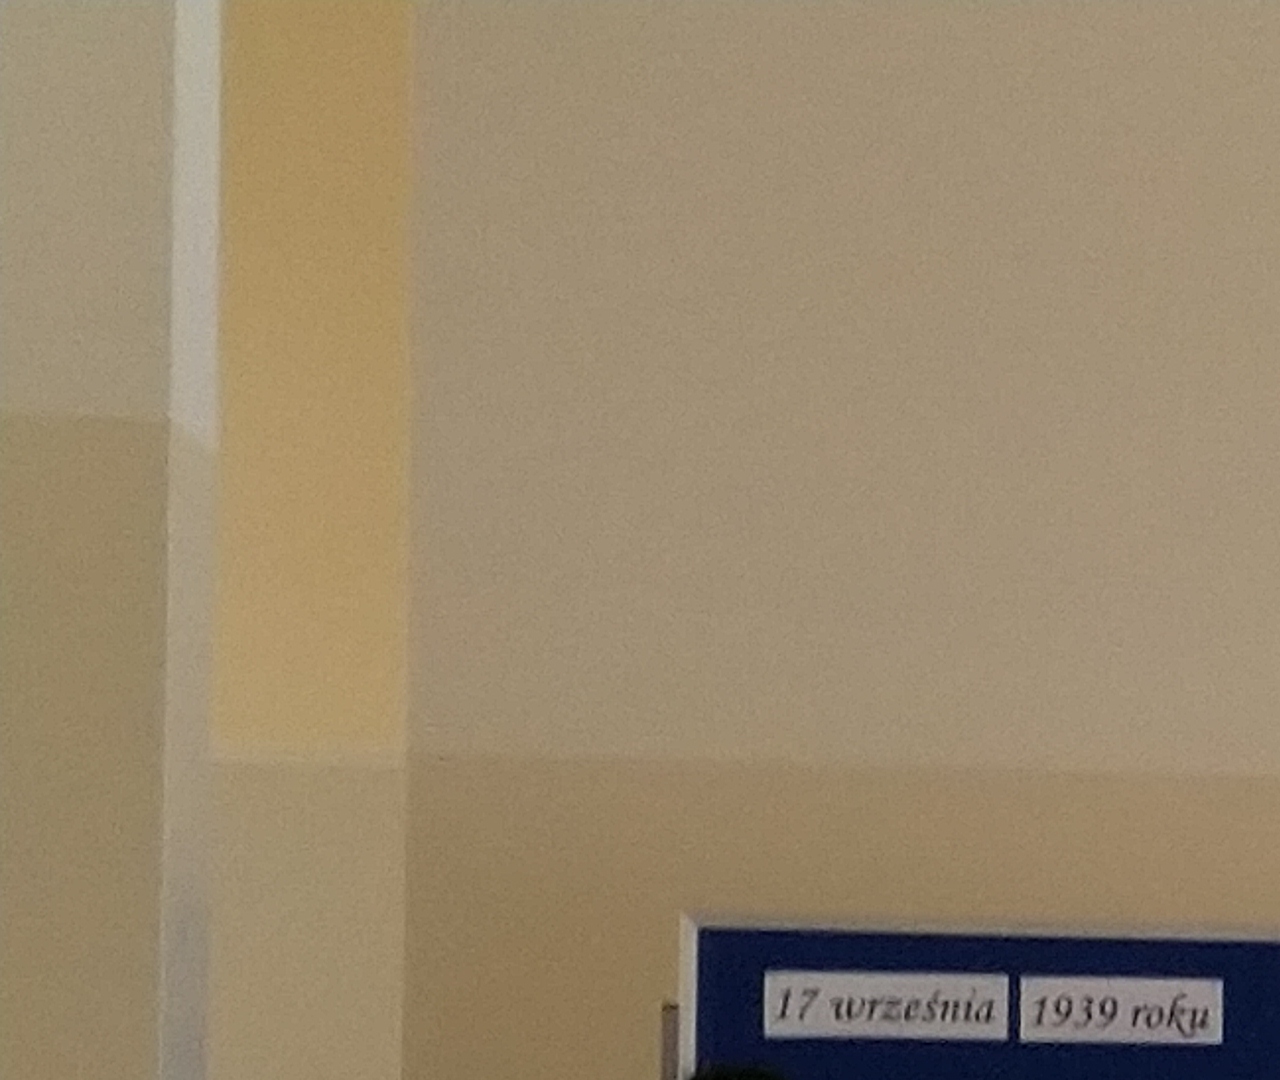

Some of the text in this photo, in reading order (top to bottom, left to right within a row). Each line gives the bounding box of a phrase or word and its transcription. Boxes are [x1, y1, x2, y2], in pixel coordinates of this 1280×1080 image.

[775, 986, 1212, 1036] 17 września 1939 roku
